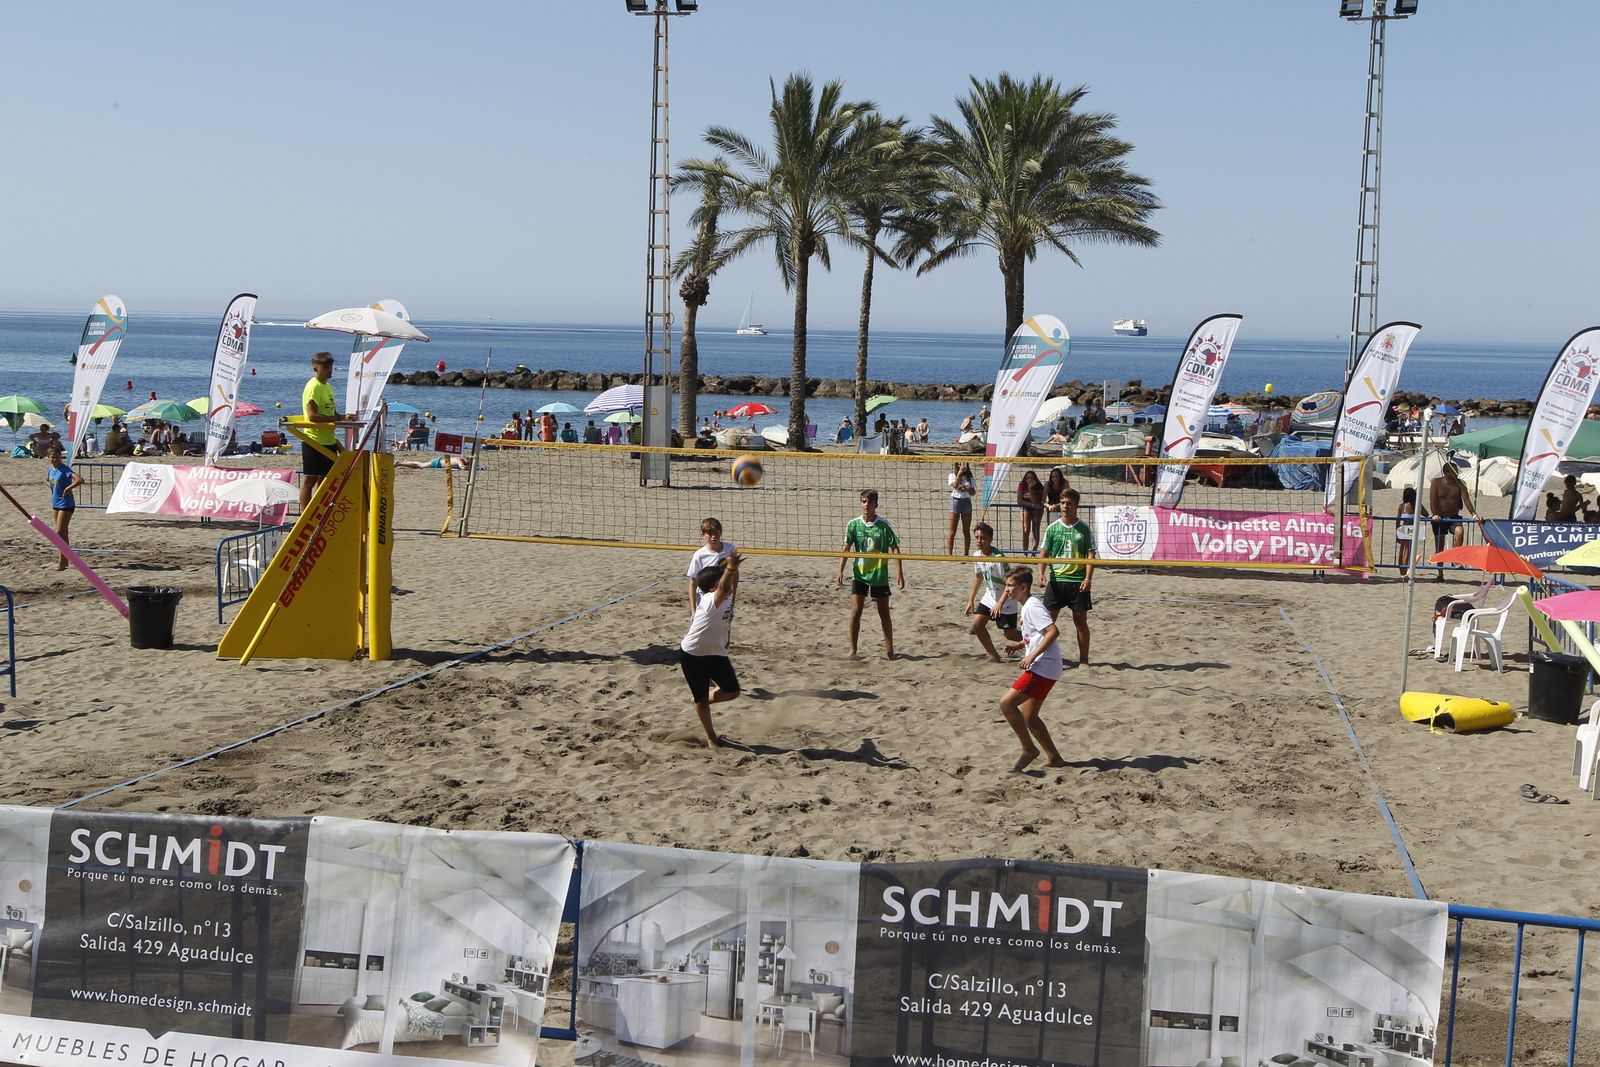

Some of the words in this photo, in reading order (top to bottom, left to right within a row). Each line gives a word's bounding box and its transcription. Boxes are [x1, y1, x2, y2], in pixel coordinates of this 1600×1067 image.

[221, 335, 244, 352] CDMA
[1185, 361, 1216, 380] CDMA
[1554, 373, 1590, 394] CDMA
[188, 468, 282, 481] Mintonette
[381, 468, 389, 494] SPORT
[178, 496, 225, 513] Voley
[227, 501, 275, 517] Playa
[324, 495, 354, 537] SPORT
[378, 497, 387, 545] ERHARD
[1109, 523, 1144, 533] MINTO
[1169, 512, 1280, 532] Mintonette
[1284, 518, 1364, 538] Almeía
[1512, 526, 1600, 535] DEPORT
[1192, 532, 1265, 560] Voley
[1515, 535, 1539, 548] DE
[67, 867, 108, 882] Porque
[114, 871, 126, 882] tú
[131, 876, 145, 884] no
[150, 877, 174, 887] eres
[180, 880, 212, 890] como
[218, 881, 235, 892] los
[241, 883, 283, 896] demás.
[107, 912, 187, 936] C/Salzillo,
[80, 933, 127, 952] Salida
[133, 939, 163, 955] 429
[168, 942, 254, 964] Aguadulce
[880, 927, 926, 942] Porque
[933, 930, 945, 941] tú
[952, 934, 967, 943] no
[974, 935, 1001, 946] eres
[1008, 938, 1043, 948] como
[1050, 938, 1069, 950] los
[1075, 941, 1121, 954] demás.
[928, 973, 1018, 996] C/Salzillo,
[70, 988, 252, 1017] www.homedesign.schmidt
[900, 996, 952, 1015] Salida
[959, 1000, 993, 1017] 429
[998, 1003, 1093, 1025] Aguadulce
[12, 1032, 129, 1061] MUEBLES
[143, 1046, 177, 1067] DE
